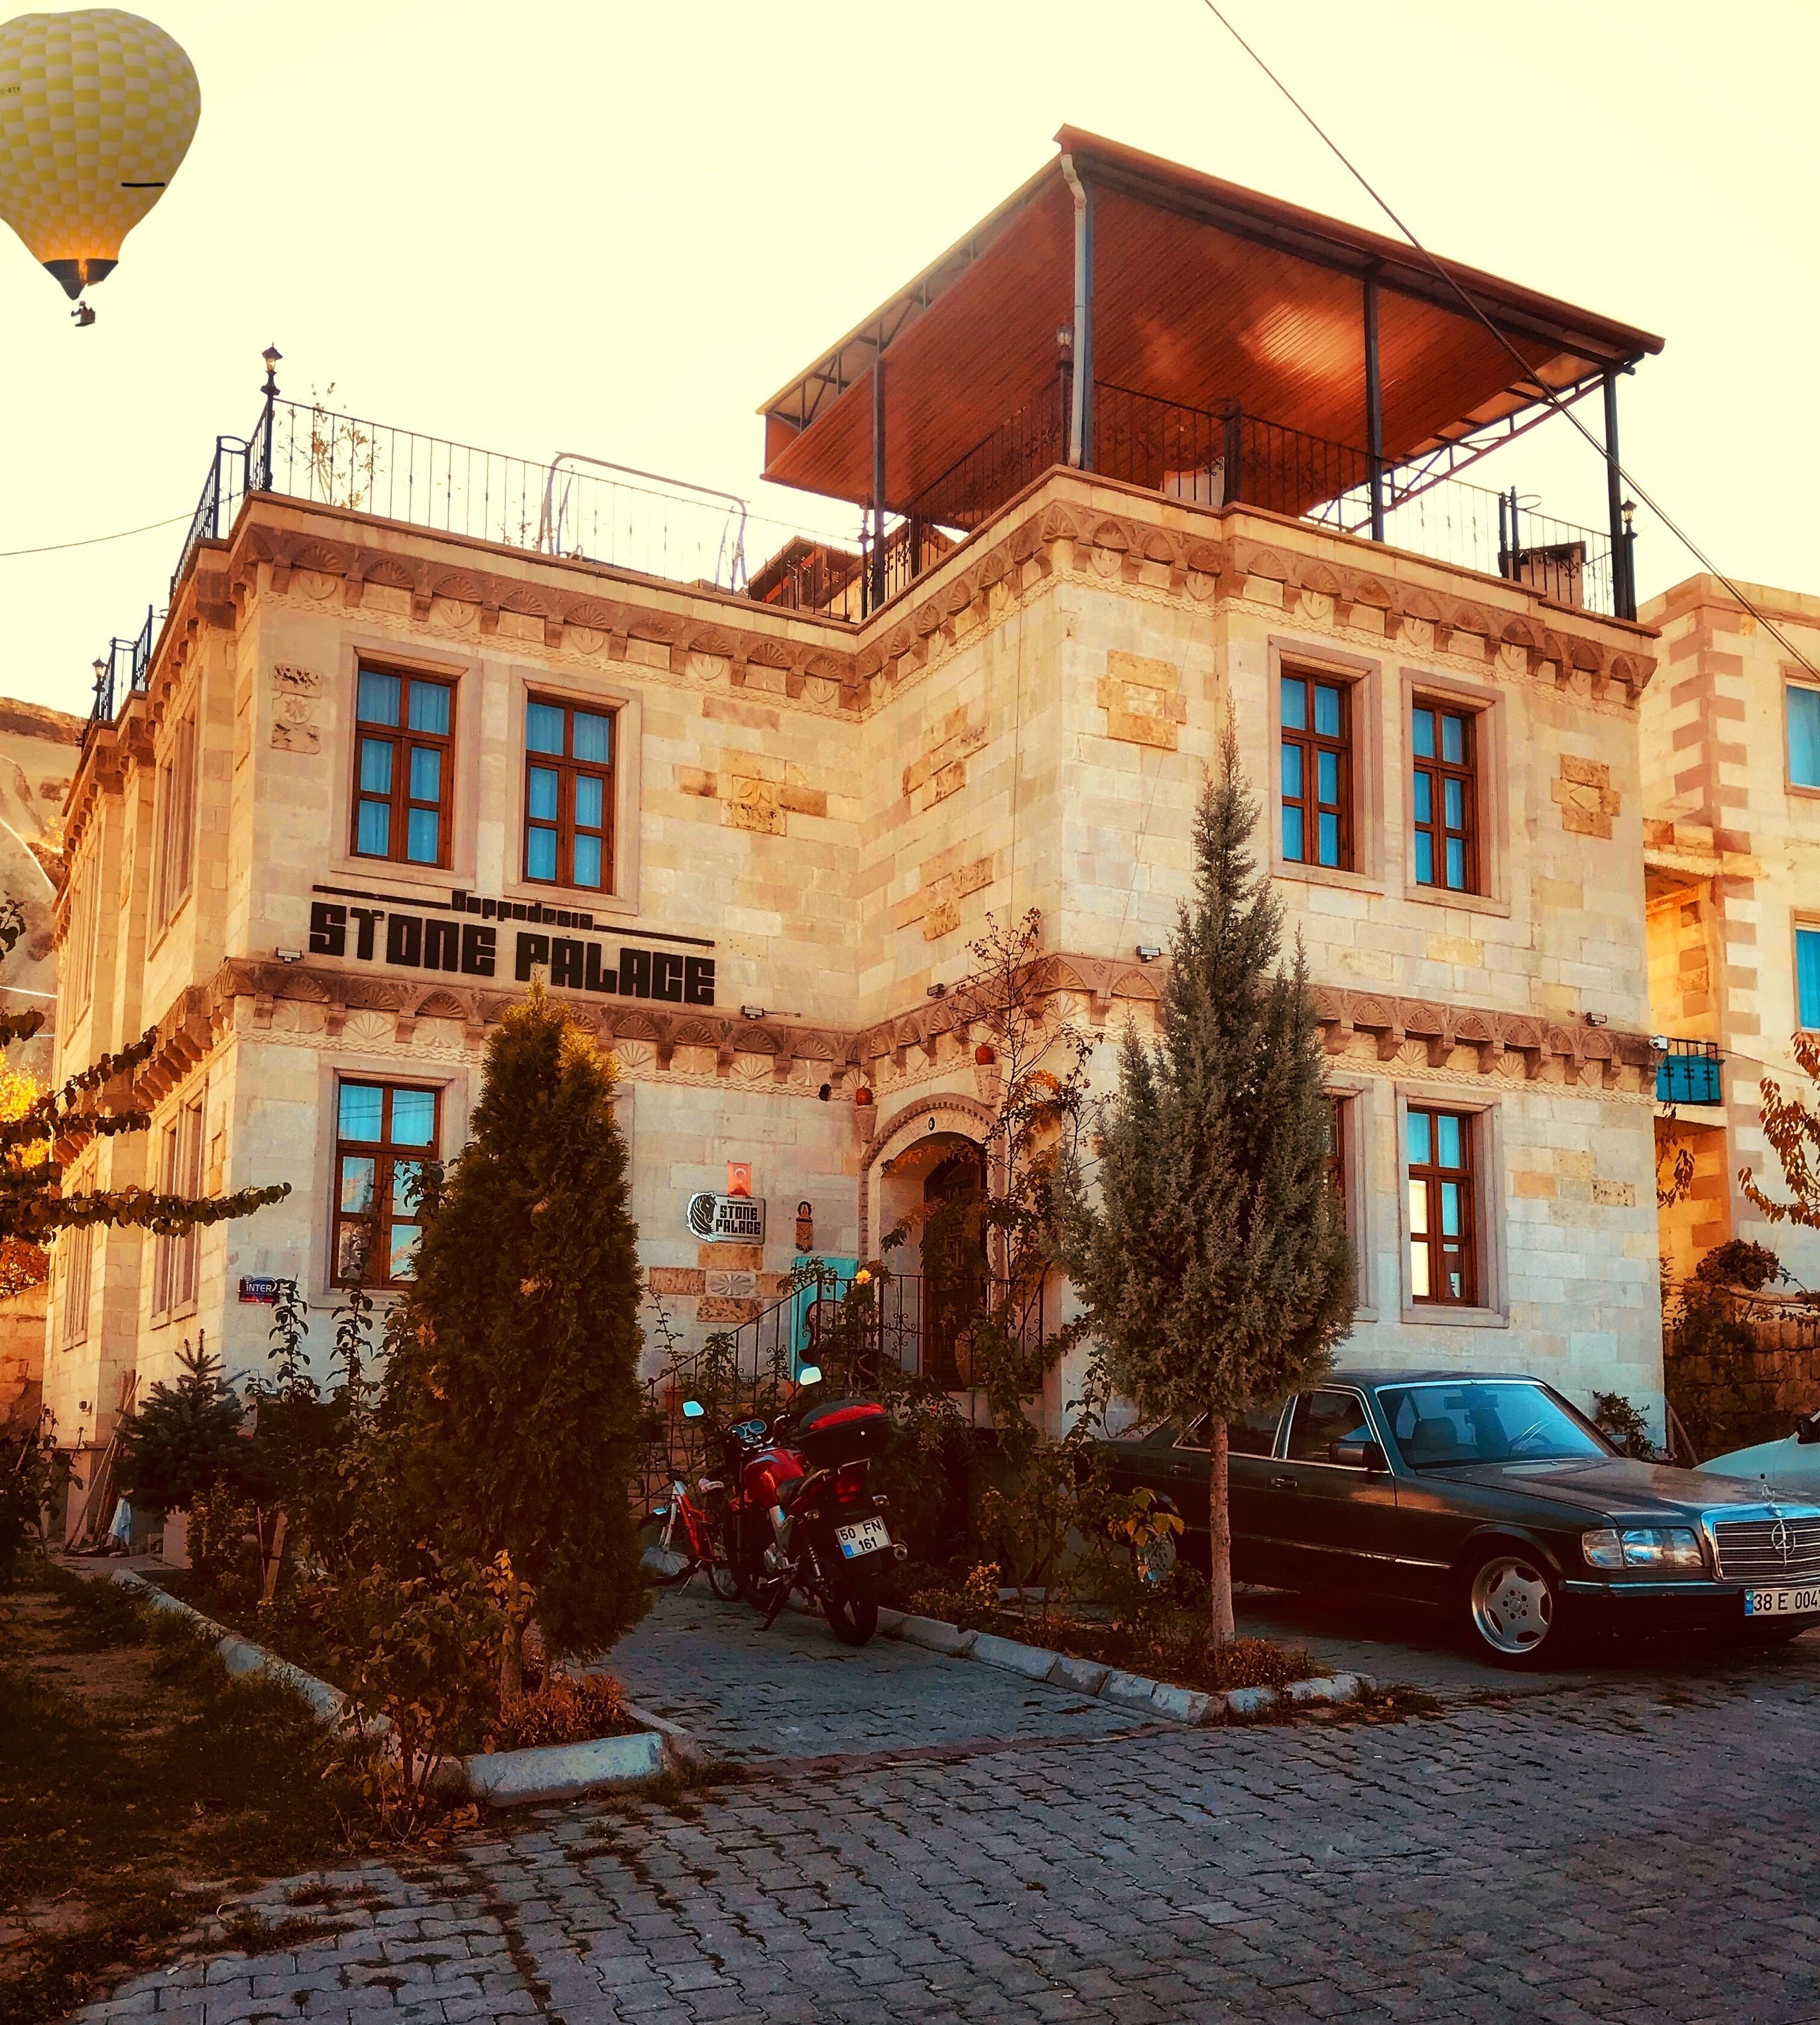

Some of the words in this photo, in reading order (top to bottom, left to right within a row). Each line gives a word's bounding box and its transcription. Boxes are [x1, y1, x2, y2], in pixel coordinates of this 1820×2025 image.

[309, 901, 497, 977] STONE
[515, 931, 715, 1005] PALACE
[720, 1205, 758, 1221] STONE
[715, 1218, 761, 1235] PALACE
[839, 1528, 856, 1540] 50
[862, 1520, 882, 1535] FN
[859, 1536, 877, 1551] 161
[1754, 1593, 1772, 1611] 38
[1778, 1592, 1789, 1611] E
[1795, 1589, 1820, 1609] 004
